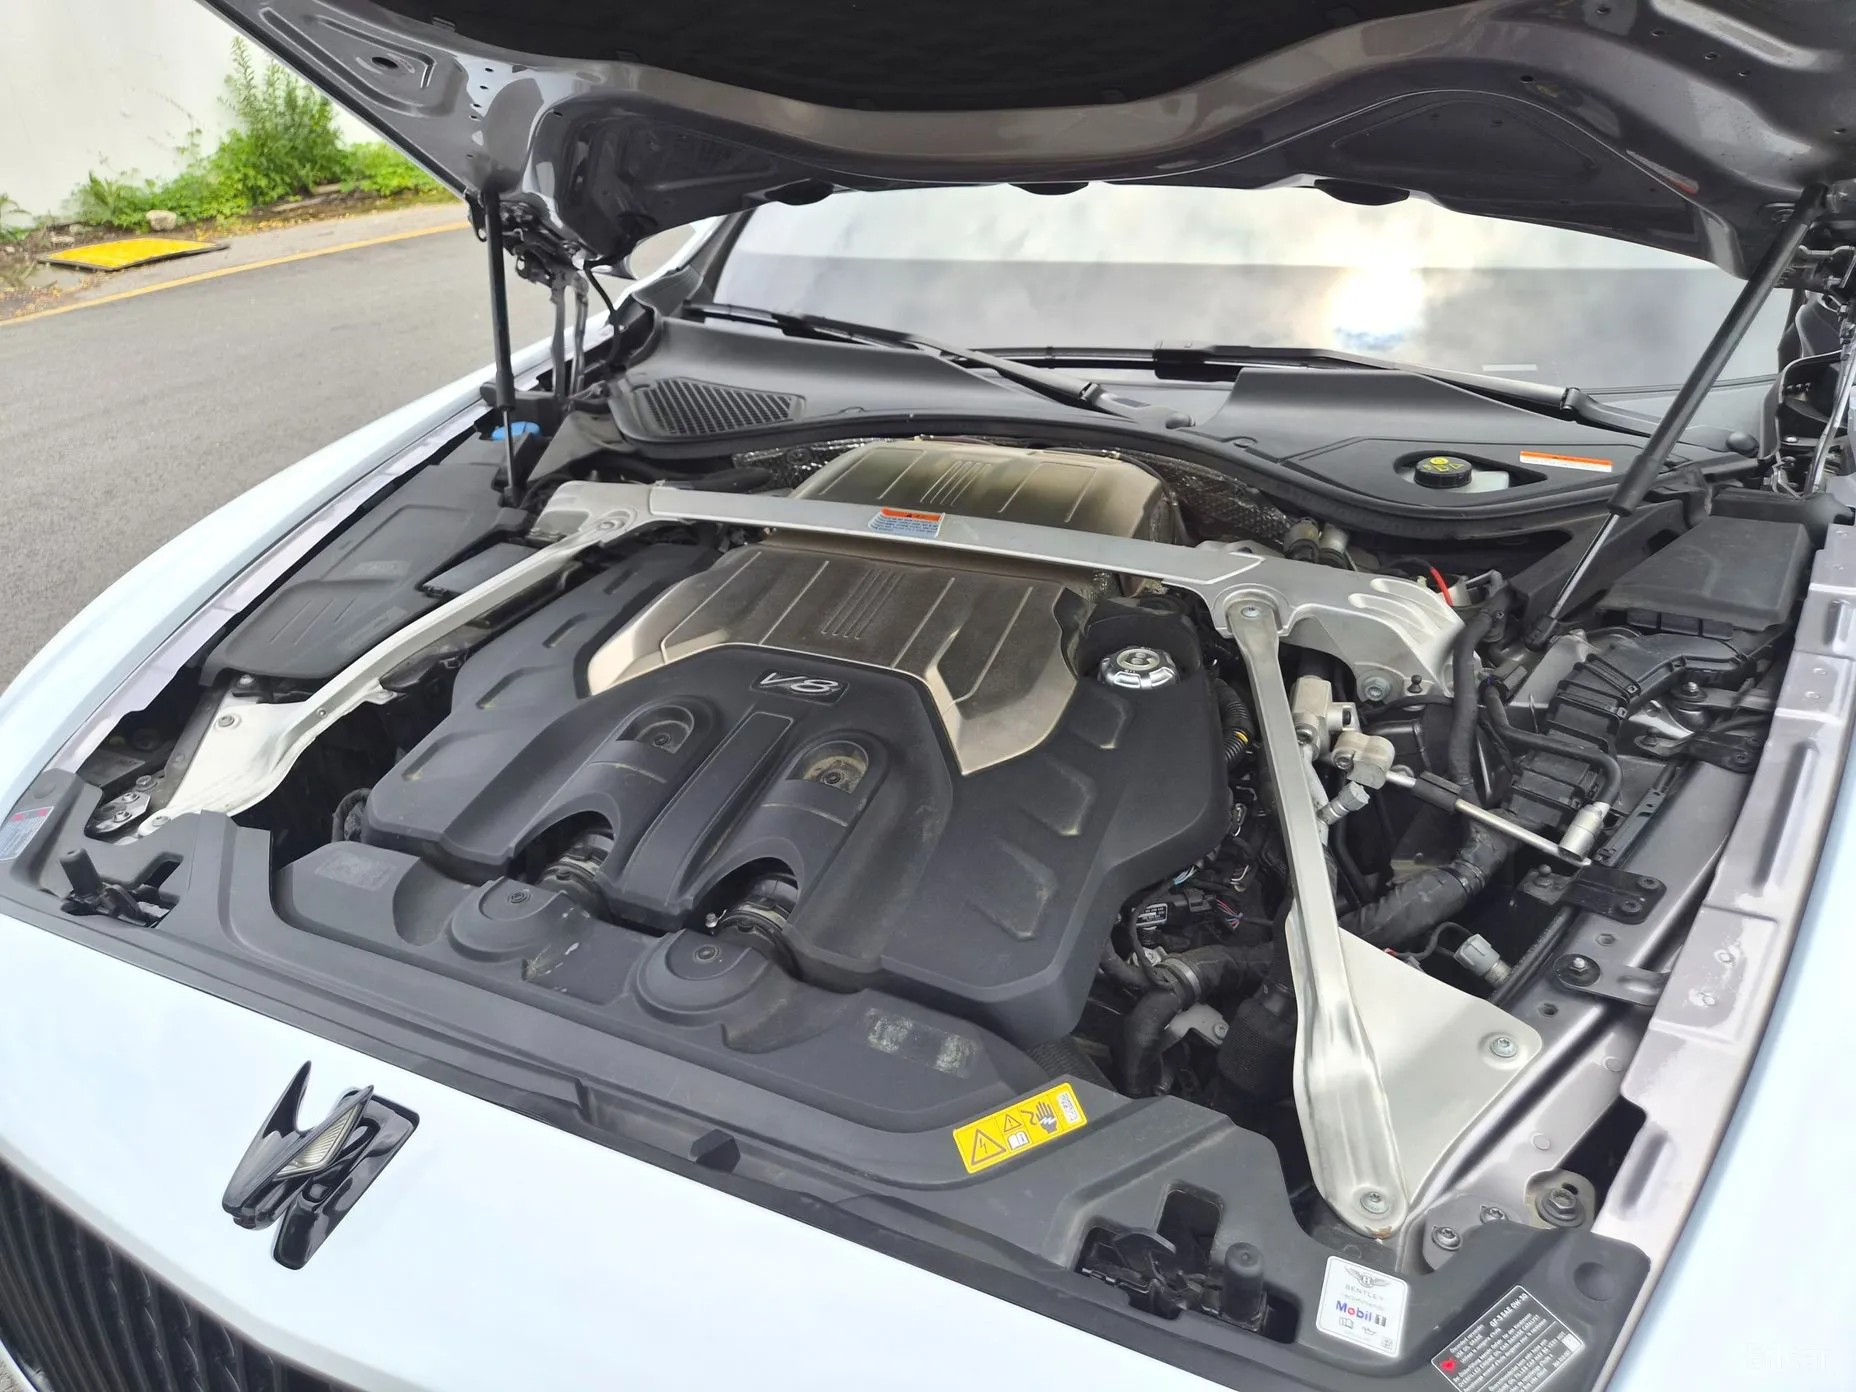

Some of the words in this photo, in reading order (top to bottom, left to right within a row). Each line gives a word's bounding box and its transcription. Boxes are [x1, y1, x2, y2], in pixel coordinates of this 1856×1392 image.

[760, 672, 839, 693] V8
[1344, 1283, 1385, 1301] BENTLEY
[1335, 1300, 1373, 1322] Mobil
